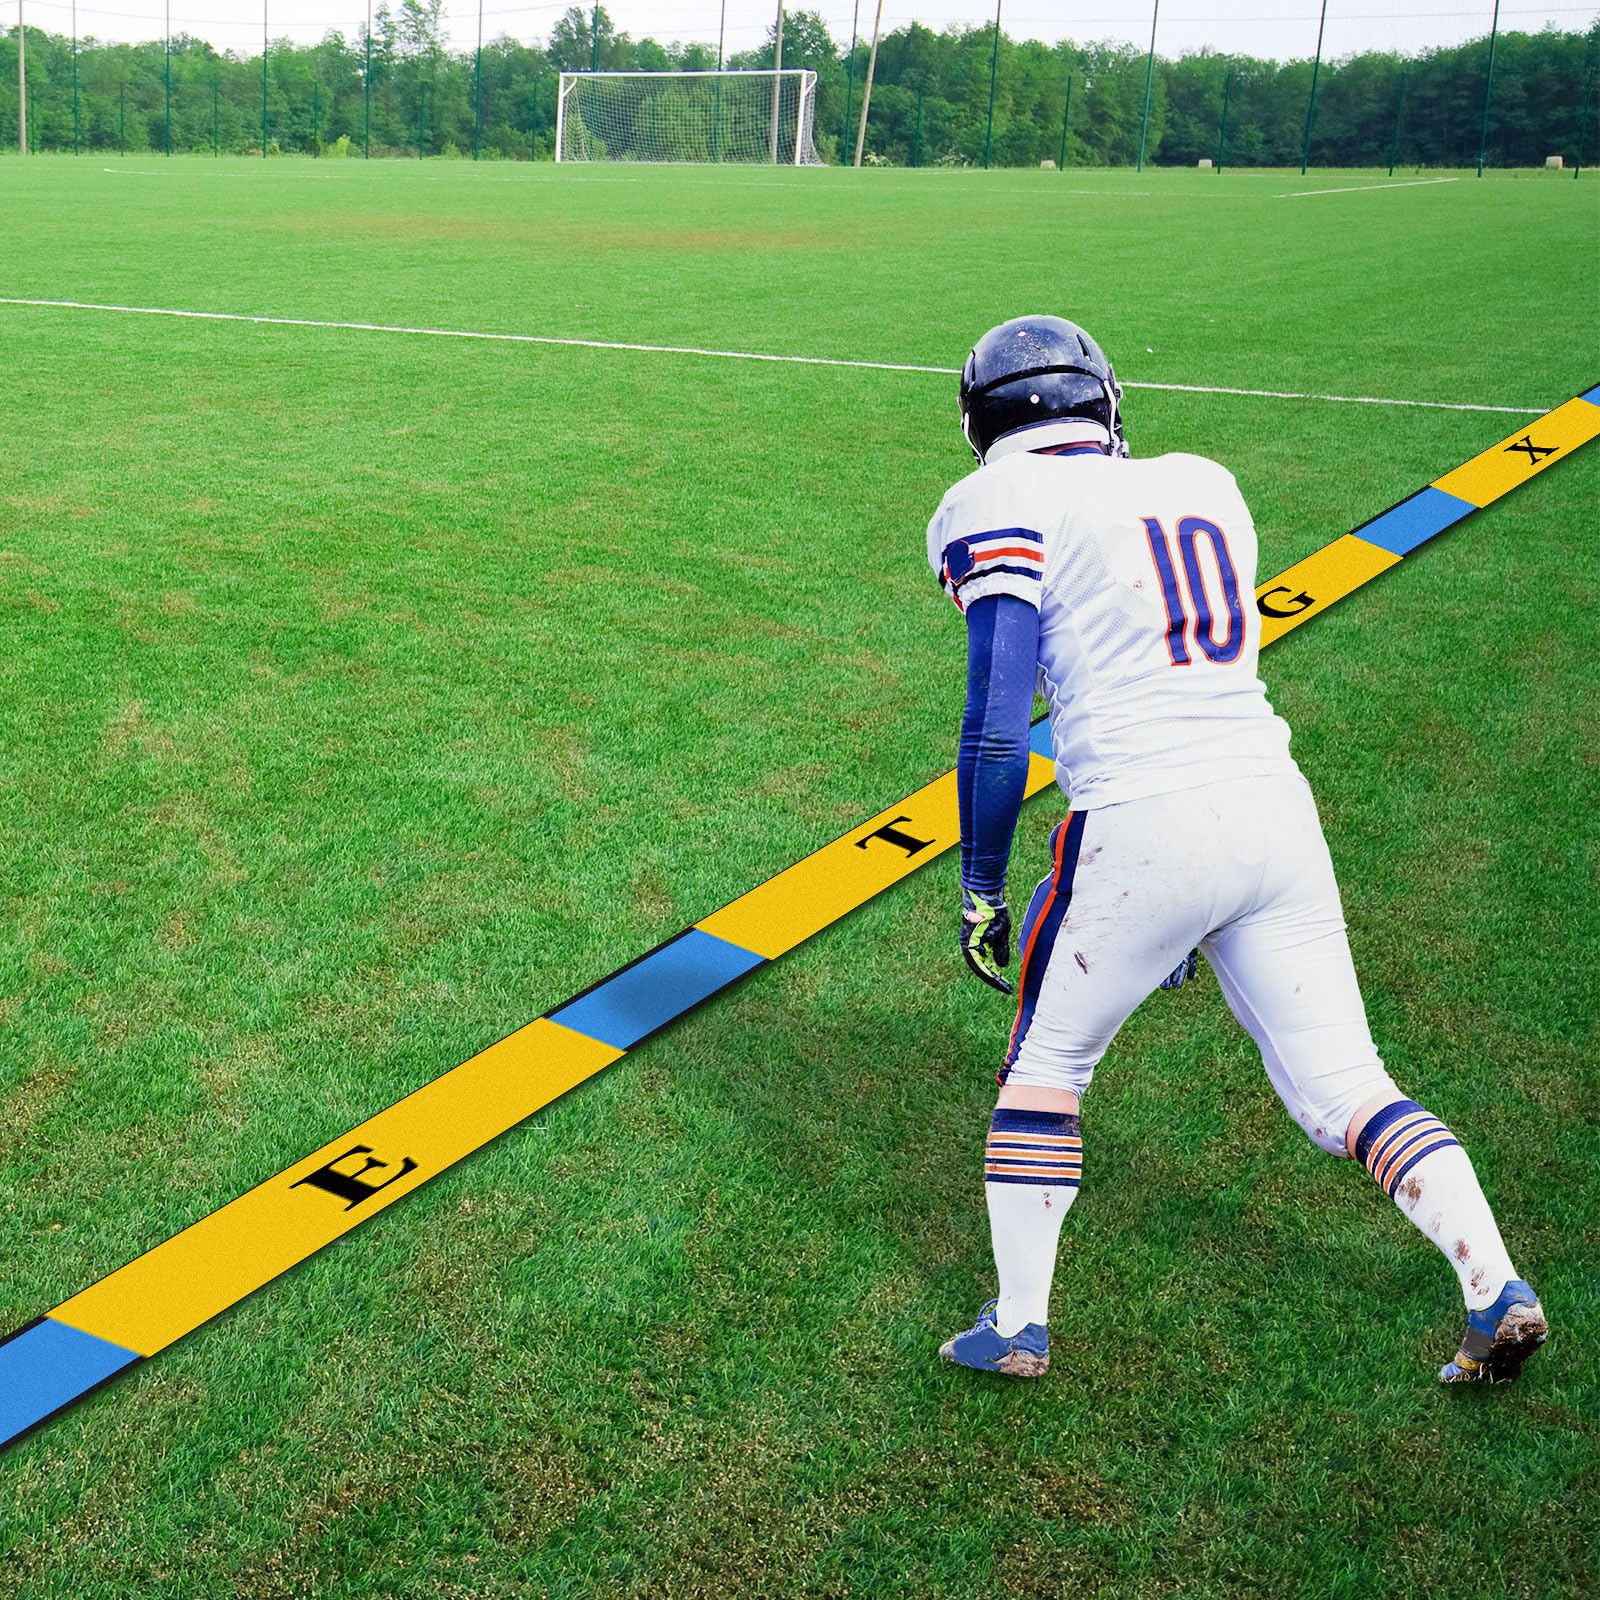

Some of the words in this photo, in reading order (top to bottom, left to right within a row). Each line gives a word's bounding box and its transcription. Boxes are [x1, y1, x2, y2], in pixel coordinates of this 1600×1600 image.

[289, 1144, 418, 1211] E
[854, 815, 936, 859] T
[1256, 585, 1317, 619] G
[1503, 434, 1560, 466] X
[1139, 515, 1246, 667] 10
